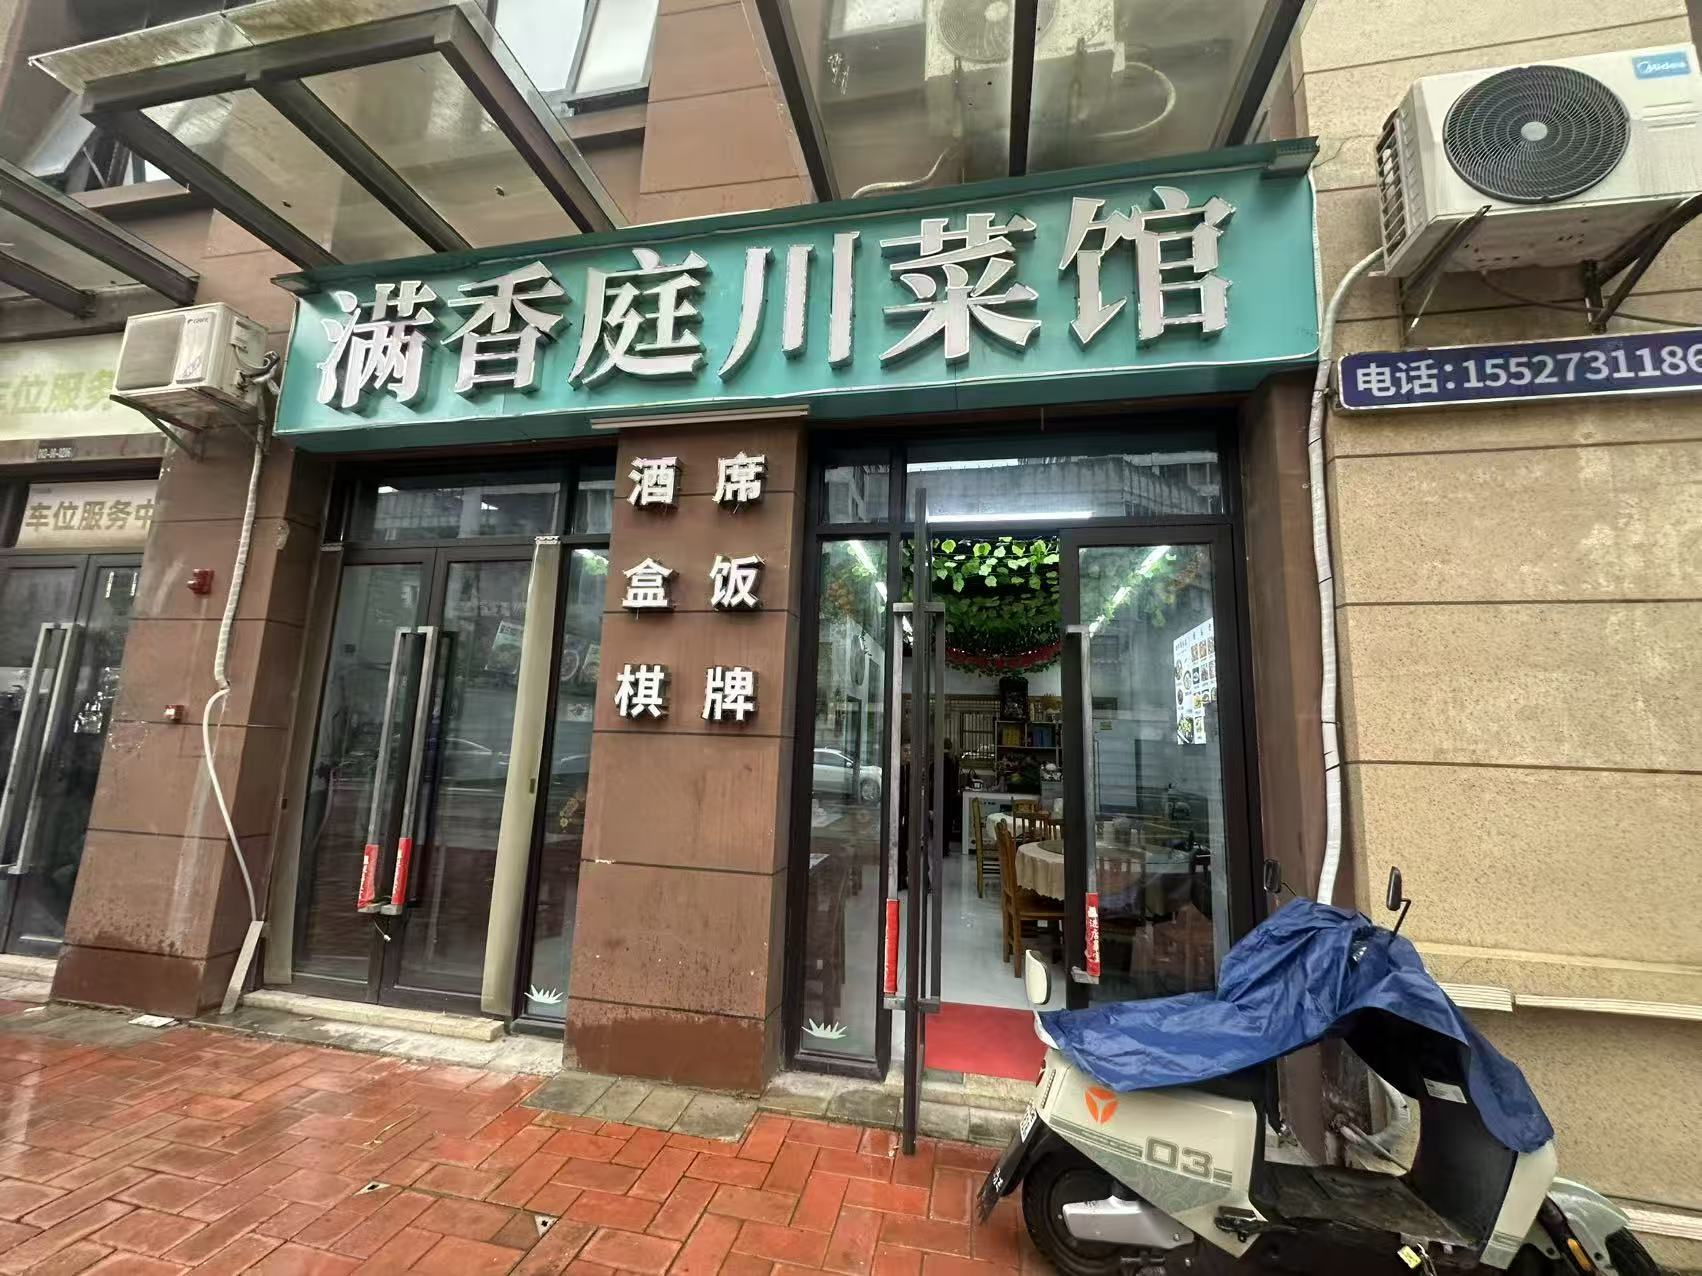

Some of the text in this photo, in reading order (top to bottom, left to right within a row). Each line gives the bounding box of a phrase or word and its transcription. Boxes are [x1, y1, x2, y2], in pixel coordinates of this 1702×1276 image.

[317, 186, 1235, 408] 满香庭川菜馆
[627, 452, 768, 505] 酒席
[25, 499, 155, 532] 车位服务中
[622, 555, 763, 608] 盒饭
[614, 664, 757, 722] 棋牌
